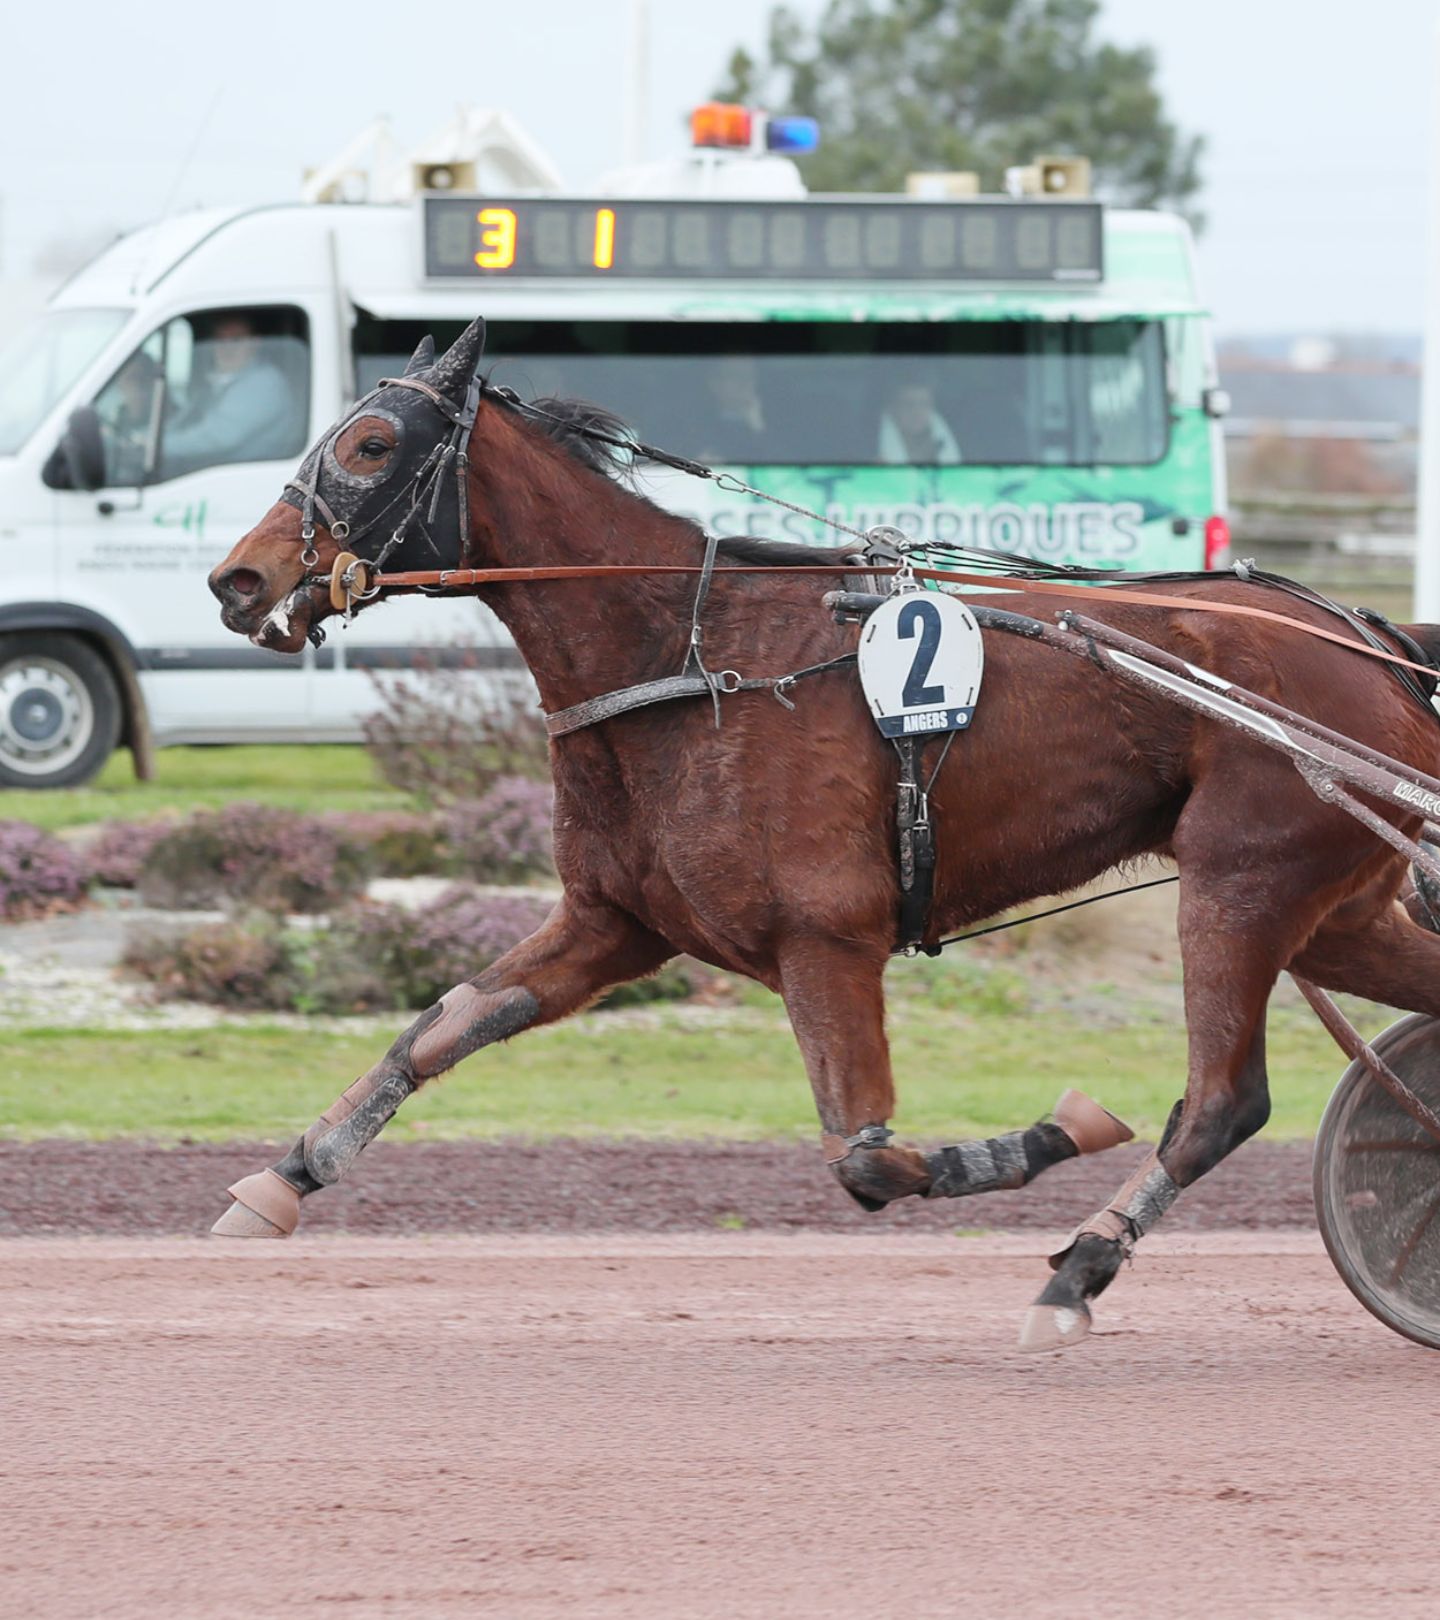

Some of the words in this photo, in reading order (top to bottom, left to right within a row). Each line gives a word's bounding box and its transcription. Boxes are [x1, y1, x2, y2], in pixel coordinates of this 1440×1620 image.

[475, 208, 517, 269] 3
[594, 208, 615, 269] 1
[897, 600, 945, 708] 2
[902, 710, 949, 733] ANGERS
